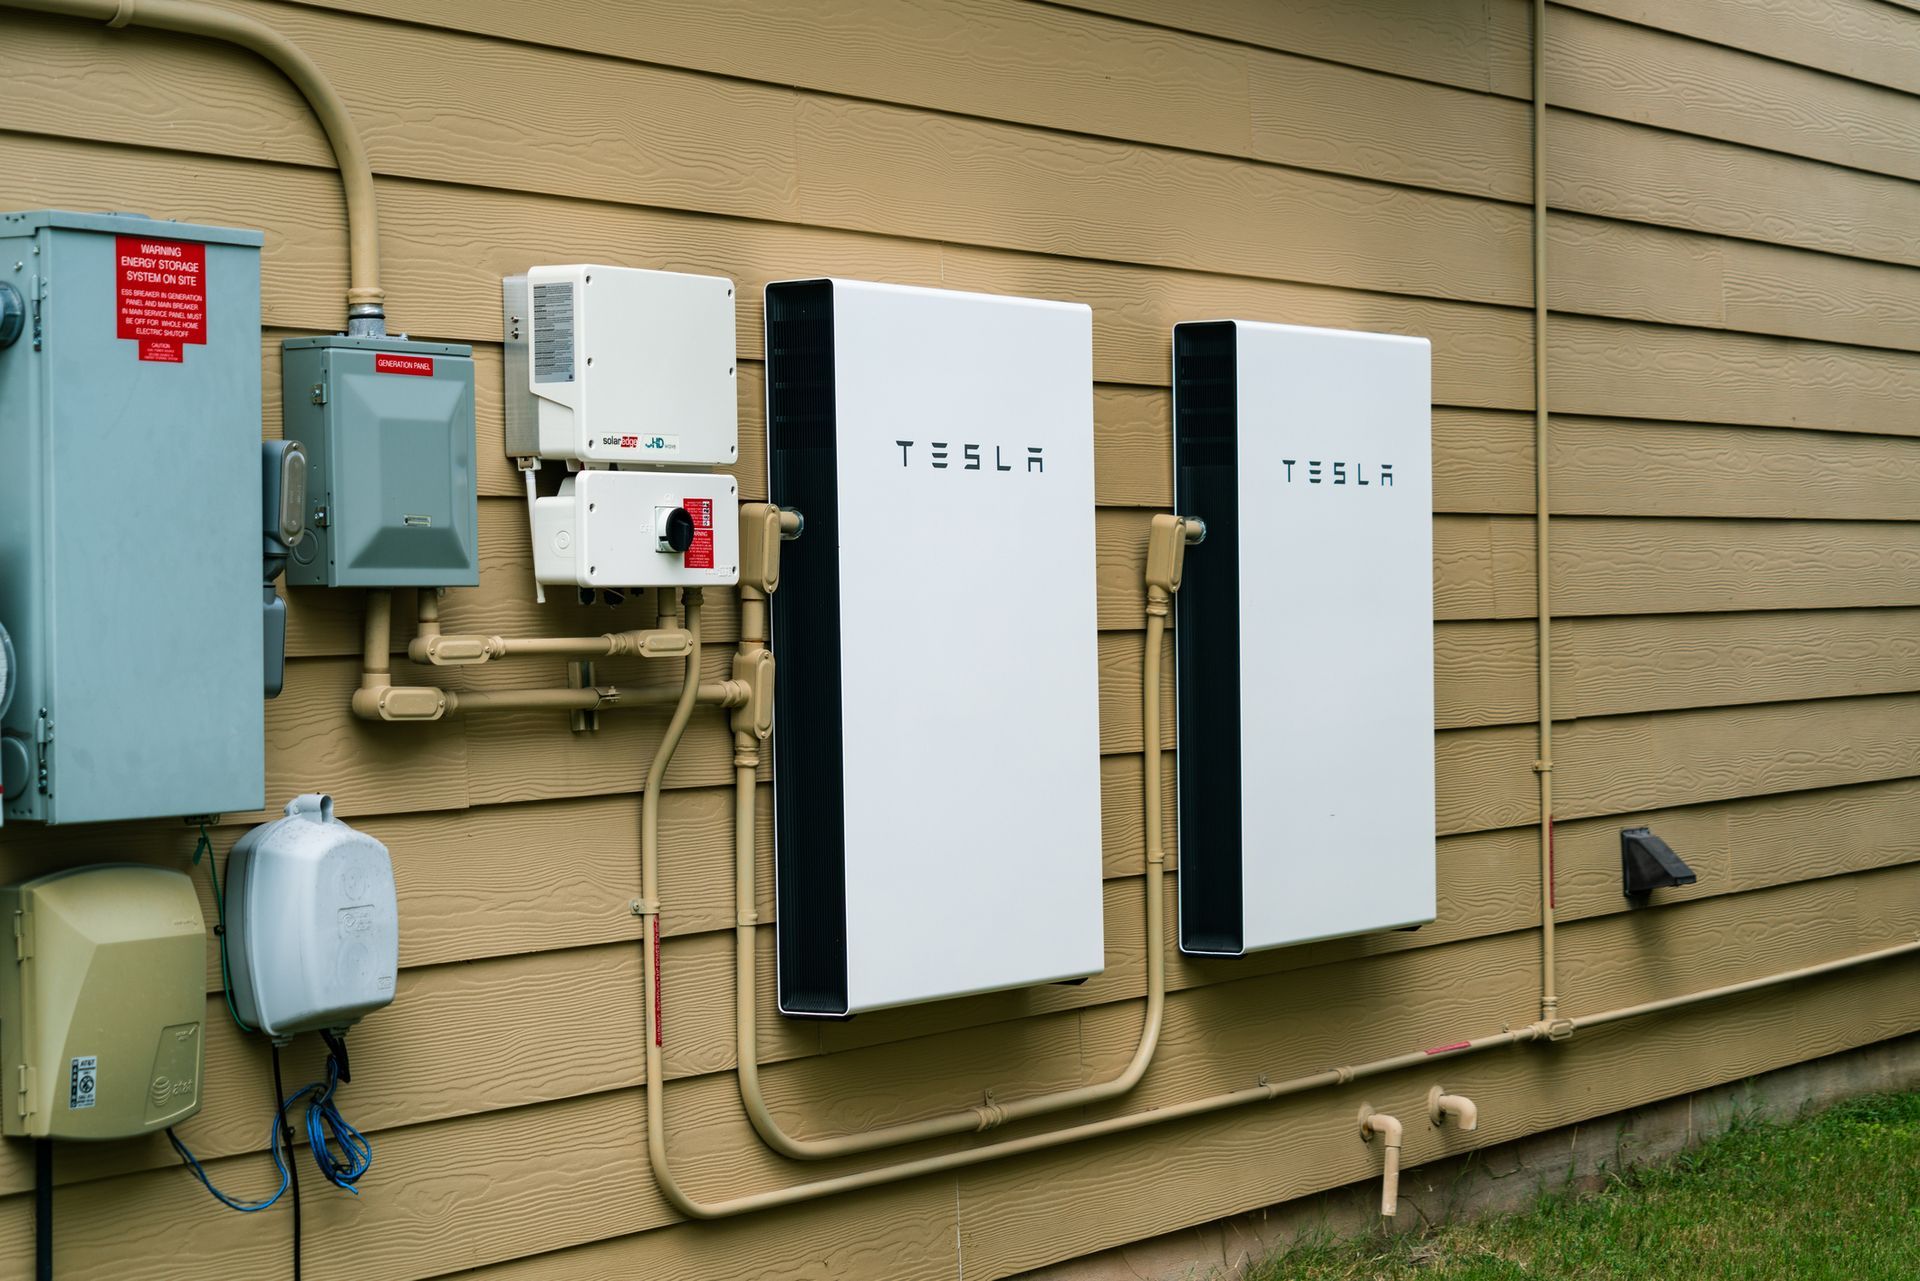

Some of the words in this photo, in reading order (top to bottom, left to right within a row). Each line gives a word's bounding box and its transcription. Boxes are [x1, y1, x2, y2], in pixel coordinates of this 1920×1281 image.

[141, 243, 182, 257] WARNING
[121, 256, 157, 269] ENERGY
[158, 259, 199, 273] STORAGE
[126, 270, 161, 283] SYSTEM
[162, 273, 176, 284] ON
[178, 275, 197, 286] SITE
[121, 288, 133, 296] ESS
[133, 289, 160, 298] BREAKER
[160, 291, 167, 299] IN
[167, 292, 203, 302] GENERATION
[125, 298, 143, 306] PANEL
[157, 301, 172, 309] MAIN
[172, 302, 199, 310] BREAKER
[128, 308, 143, 316] MAIN
[143, 309, 168, 318] SERVICE
[168, 311, 186, 319] PANEL
[187, 312, 202, 320] MUST
[161, 320, 181, 328] WHOLE
[182, 321, 199, 329] HOME
[135, 327, 163, 336] ELECTRIC
[164, 329, 189, 337] SHUTOFF
[377, 359, 413, 369] GENERATION
[413, 362, 431, 371] PANEL
[896, 440, 1043, 473] TESLA
[1282, 460, 1393, 486] TESLA
